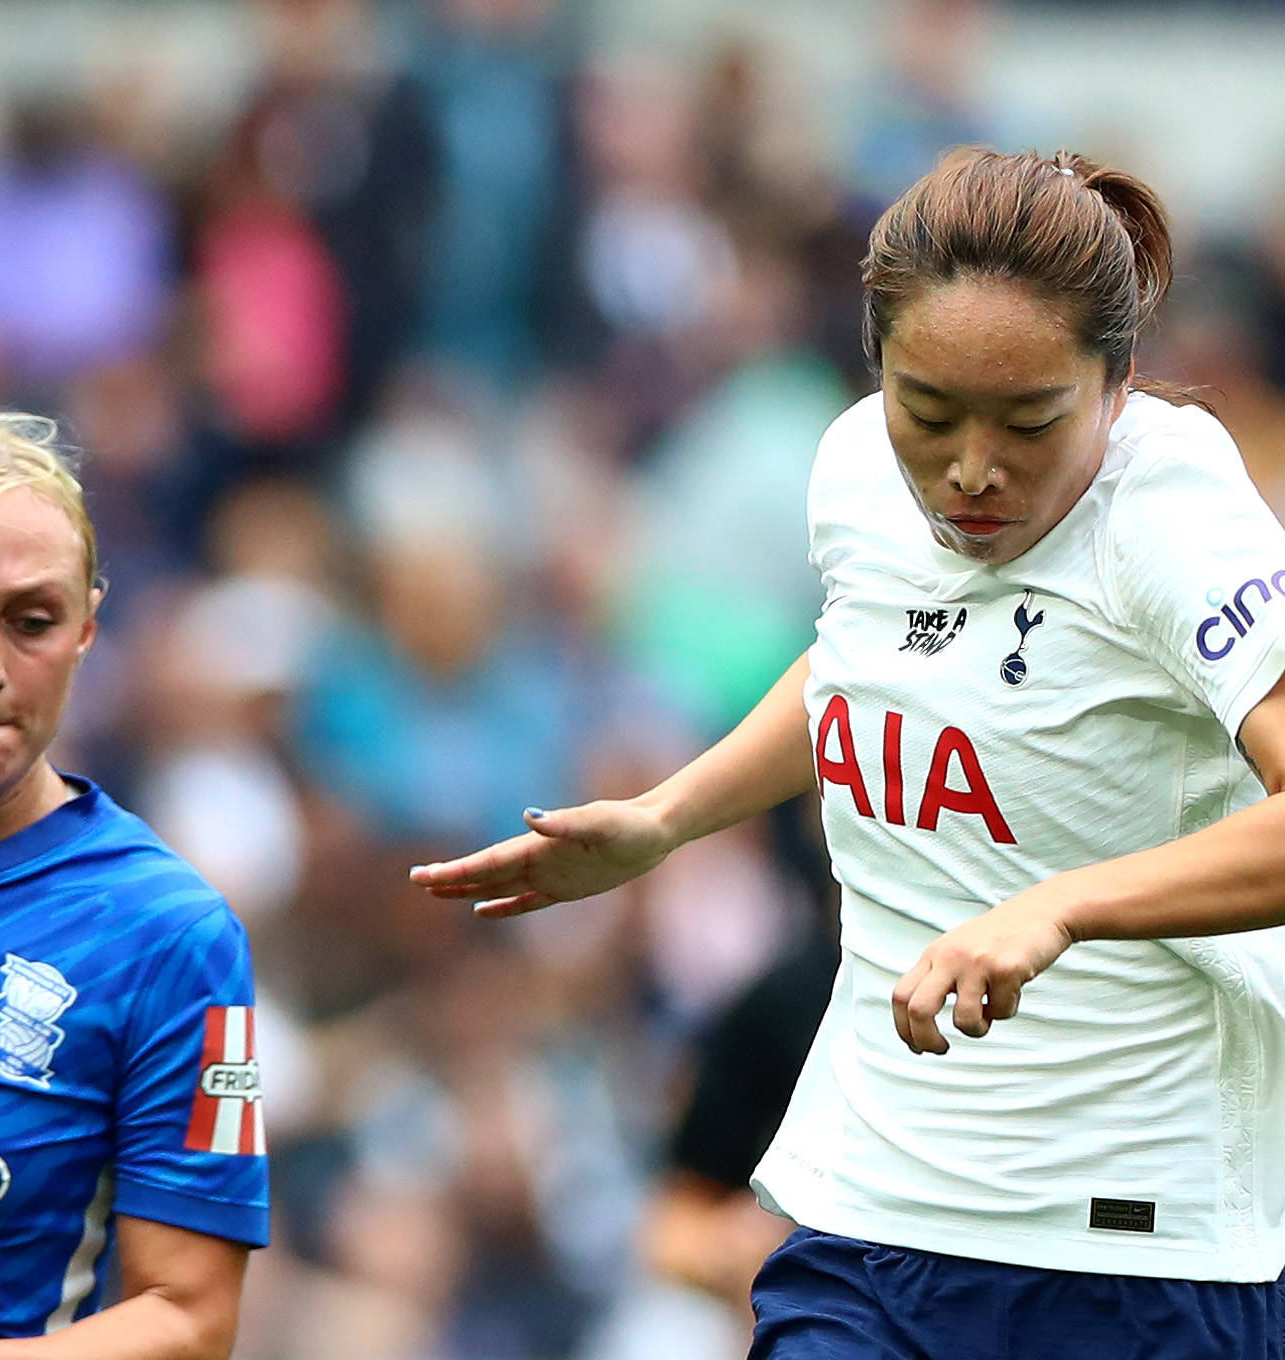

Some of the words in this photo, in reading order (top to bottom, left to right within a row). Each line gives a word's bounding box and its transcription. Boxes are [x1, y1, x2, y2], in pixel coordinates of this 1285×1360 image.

[905, 608, 949, 632] TAKE
[952, 607, 967, 633] A
[816, 694, 1019, 845] AIA
